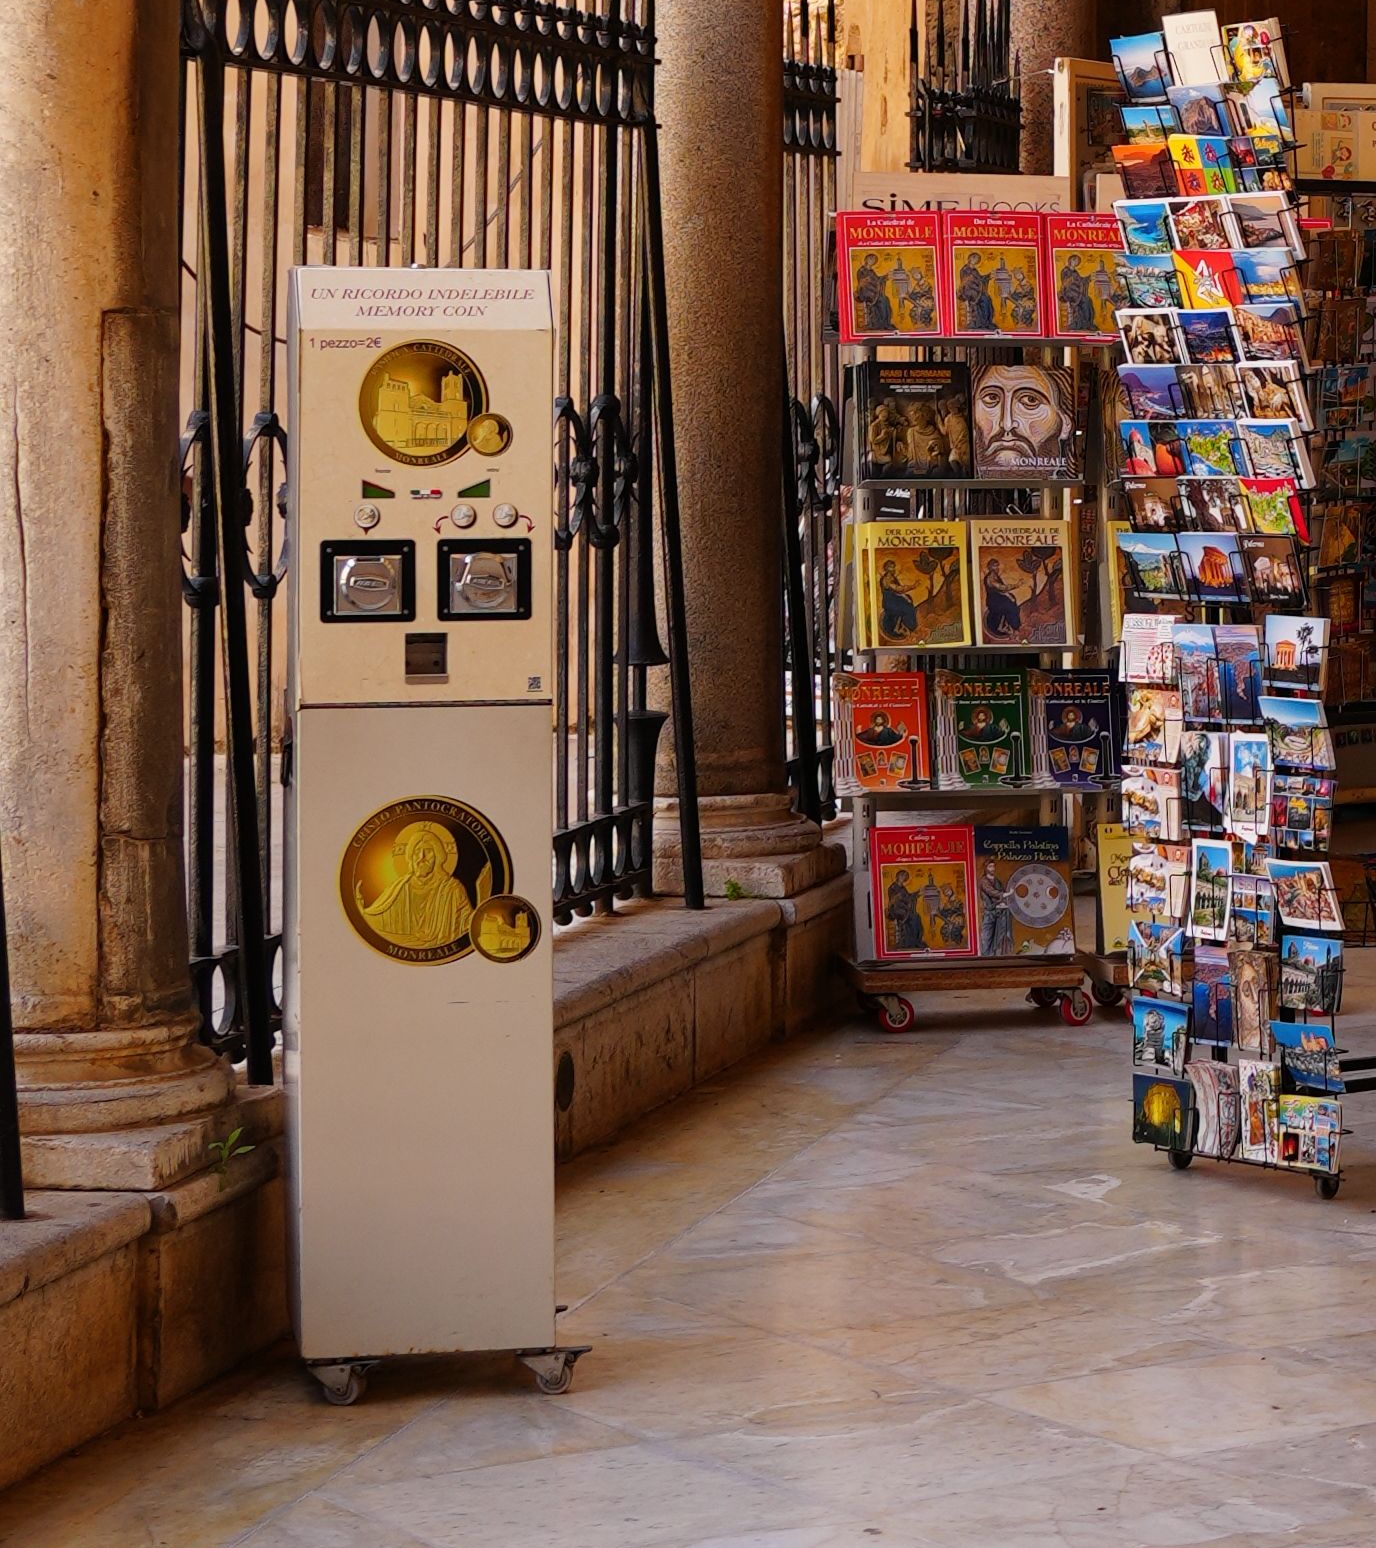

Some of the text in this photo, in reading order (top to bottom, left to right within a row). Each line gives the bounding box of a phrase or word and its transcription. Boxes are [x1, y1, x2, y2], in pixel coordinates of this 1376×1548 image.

[1066, 220, 1076, 228] La
[849, 227, 934, 240] MONREALE
[953, 227, 1038, 240] MONREALE
[310, 288, 536, 301] UN RICORDO INDELEBILE
[355, 305, 488, 317] MEMORY COIN
[309, 337, 382, 350] 1 pezzo=2€
[394, 452, 449, 466] MONREALE
[1011, 457, 1067, 467] MONREALE
[928, 528, 949, 536] VON
[978, 527, 990, 535] LA
[991, 527, 1047, 535] CATHEDRALE
[877, 535, 956, 547] MONREALE
[981, 534, 1059, 546] MONREALE
[940, 681, 1022, 697] MONREALE
[1029, 682, 1111, 697] MONREALE
[395, 800, 493, 846] PANTOCRATORE
[880, 841, 966, 855] МОНРЕАЛЕ
[983, 840, 1060, 852] Cappella Palatina
[997, 851, 1032, 861] Palazzo
[1034, 851, 1061, 861] Reale
[386, 941, 462, 961] MONREALE
